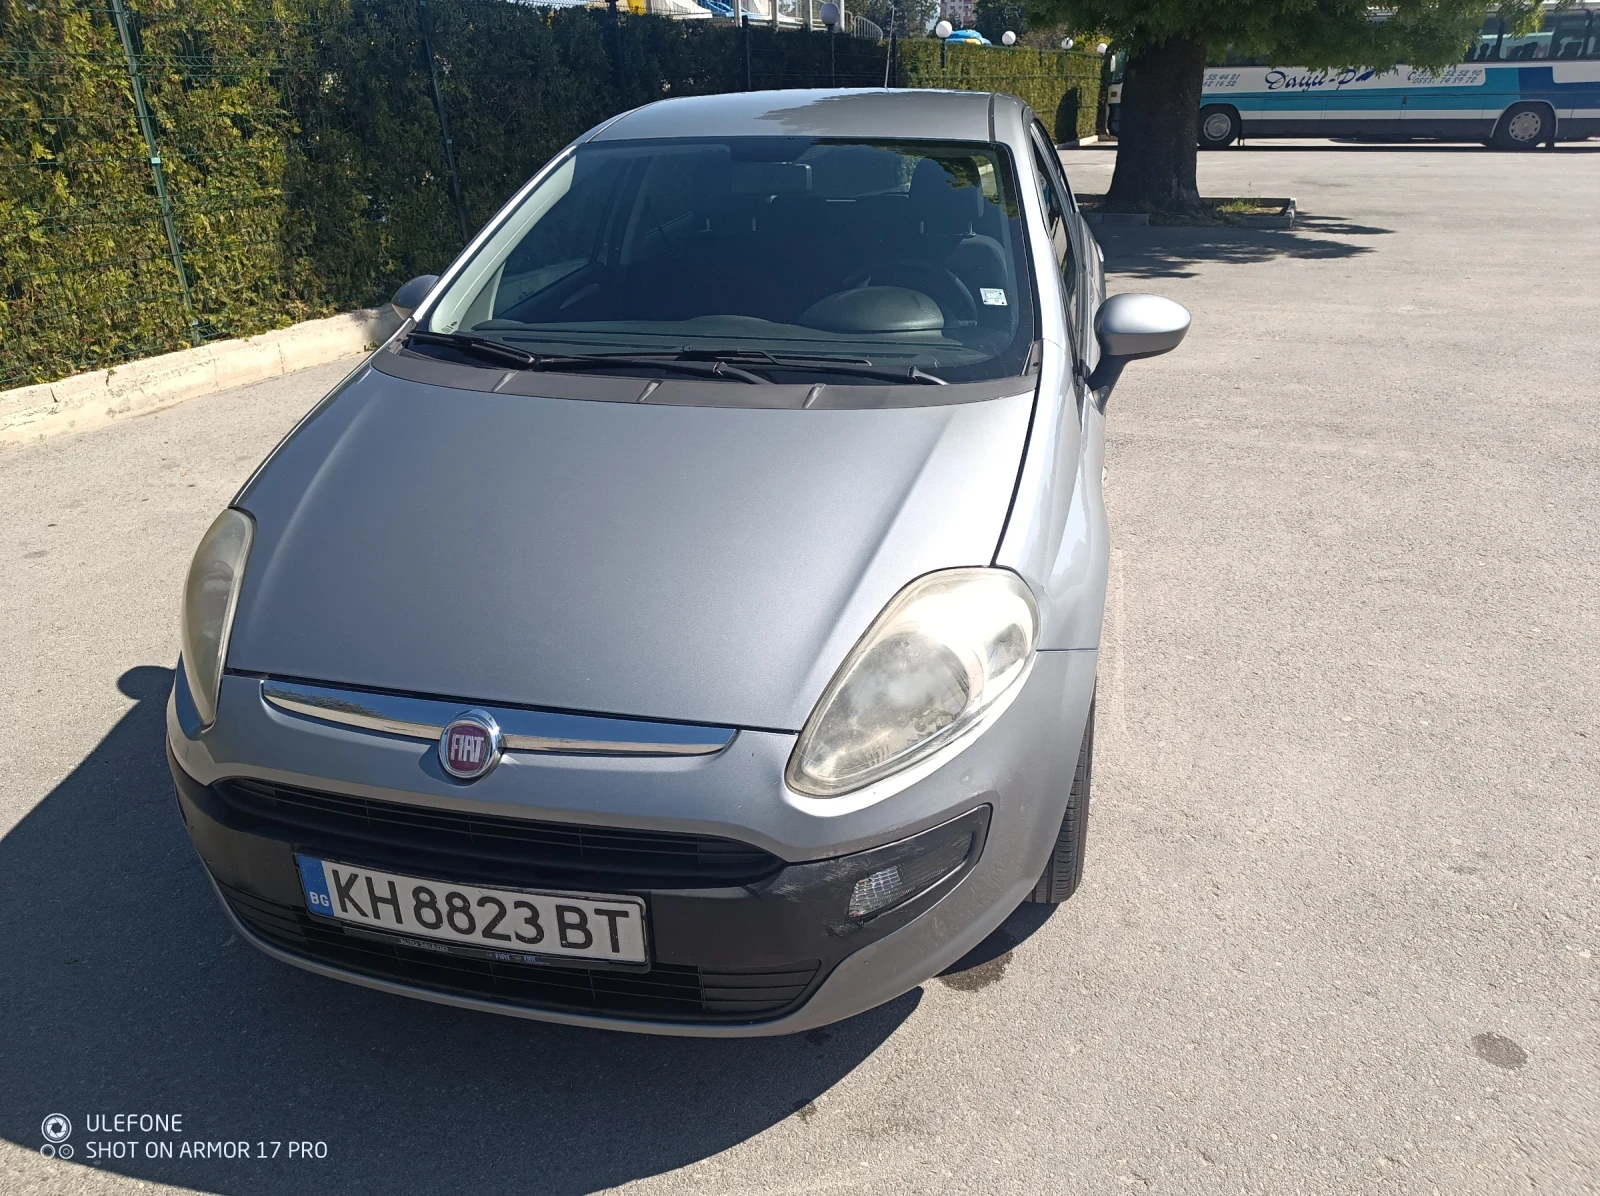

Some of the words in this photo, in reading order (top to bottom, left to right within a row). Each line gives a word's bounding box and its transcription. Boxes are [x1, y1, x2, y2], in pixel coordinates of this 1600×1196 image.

[450, 733, 485, 763] FIAT
[309, 890, 330, 907] BG
[411, 885, 545, 945] 8823
